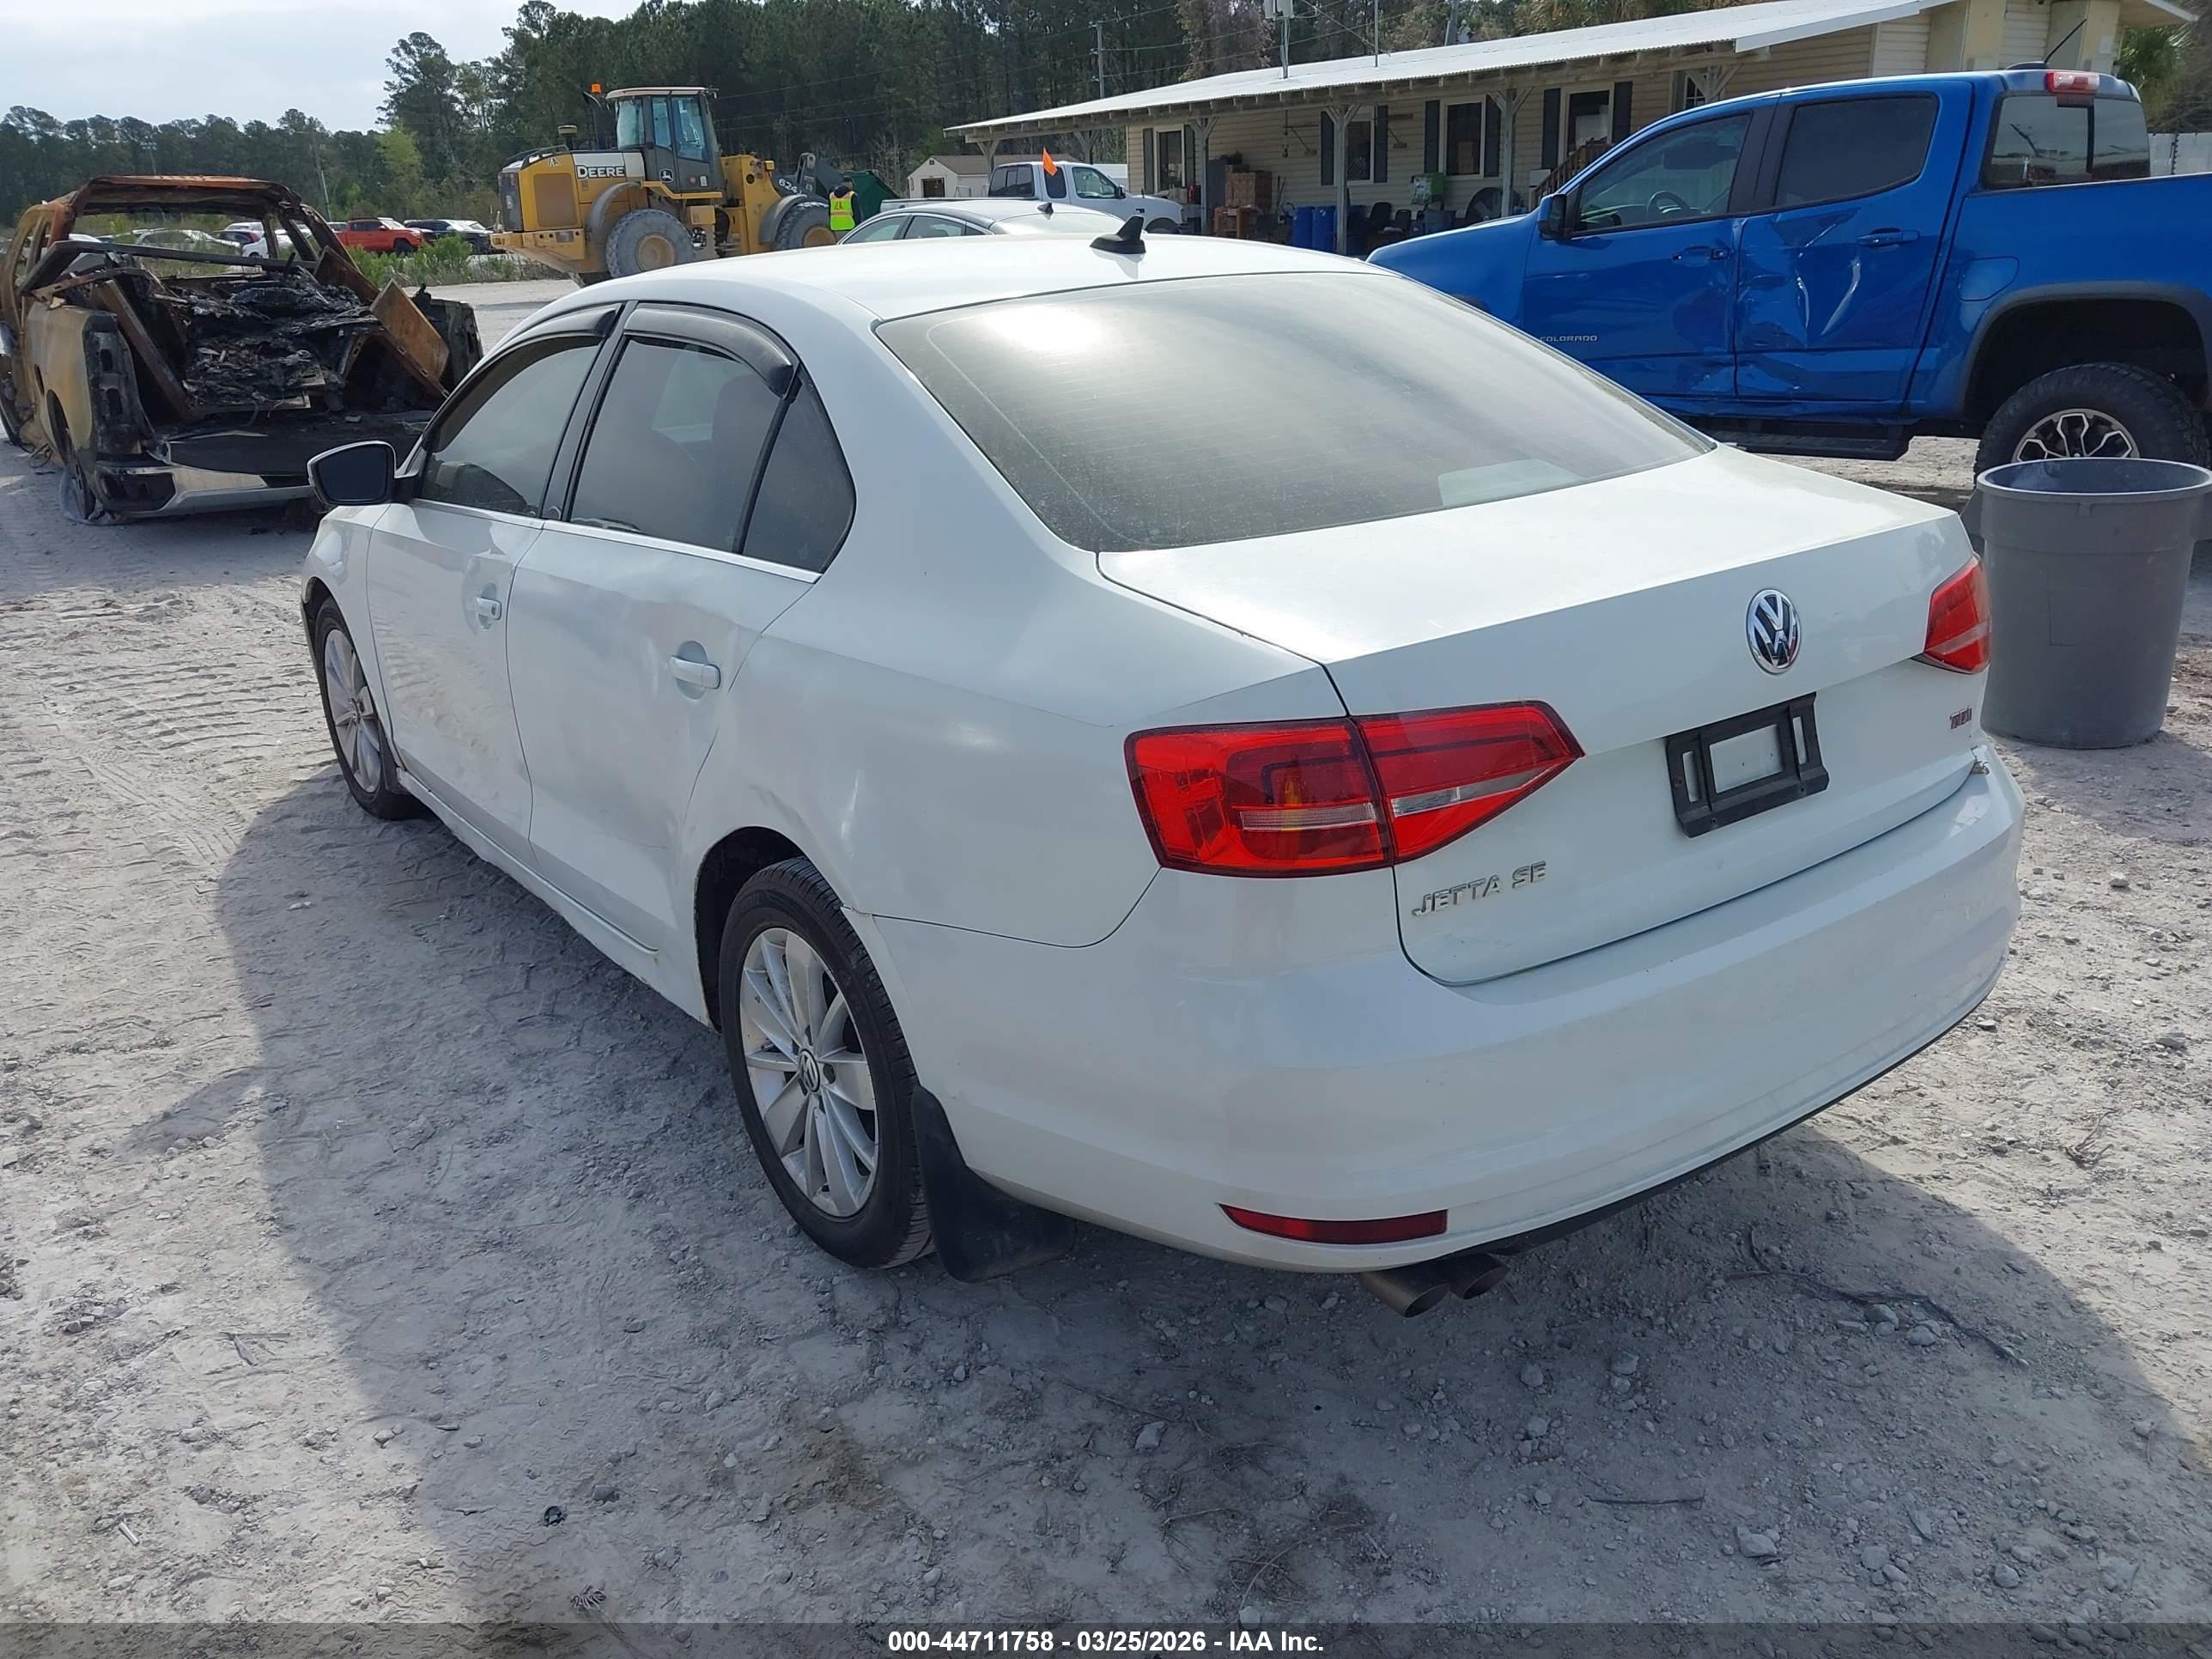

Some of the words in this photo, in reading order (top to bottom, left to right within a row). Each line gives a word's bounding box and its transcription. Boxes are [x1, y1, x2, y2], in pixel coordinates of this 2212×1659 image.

[576, 165, 625, 179] DEERE
[1949, 706, 1972, 730] TDI
[1412, 874, 1500, 916] JETTA
[1512, 860, 1547, 889] SE
